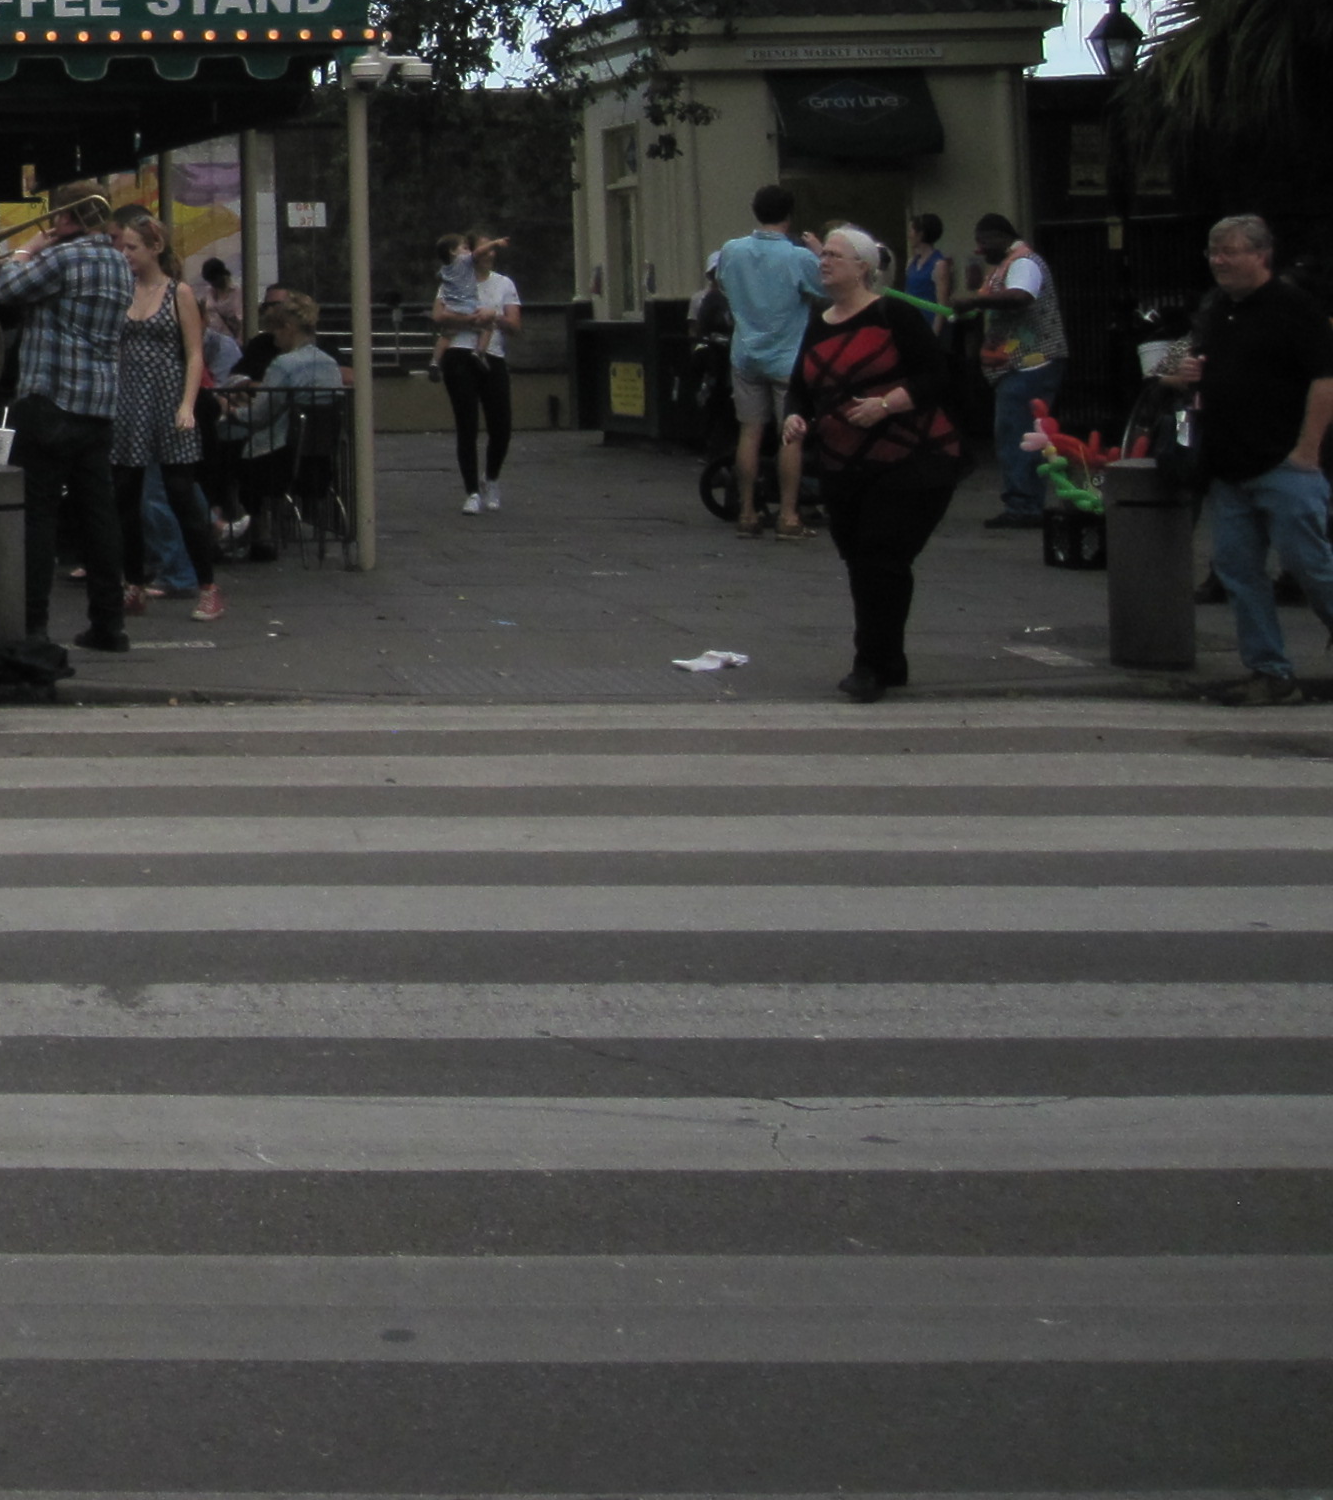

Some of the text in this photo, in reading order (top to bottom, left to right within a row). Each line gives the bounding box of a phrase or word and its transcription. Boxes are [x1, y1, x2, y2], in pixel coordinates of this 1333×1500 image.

[752, 47, 937, 59] FRENCH MARKET INFORMATION
[807, 95, 900, 109] Gray Line
